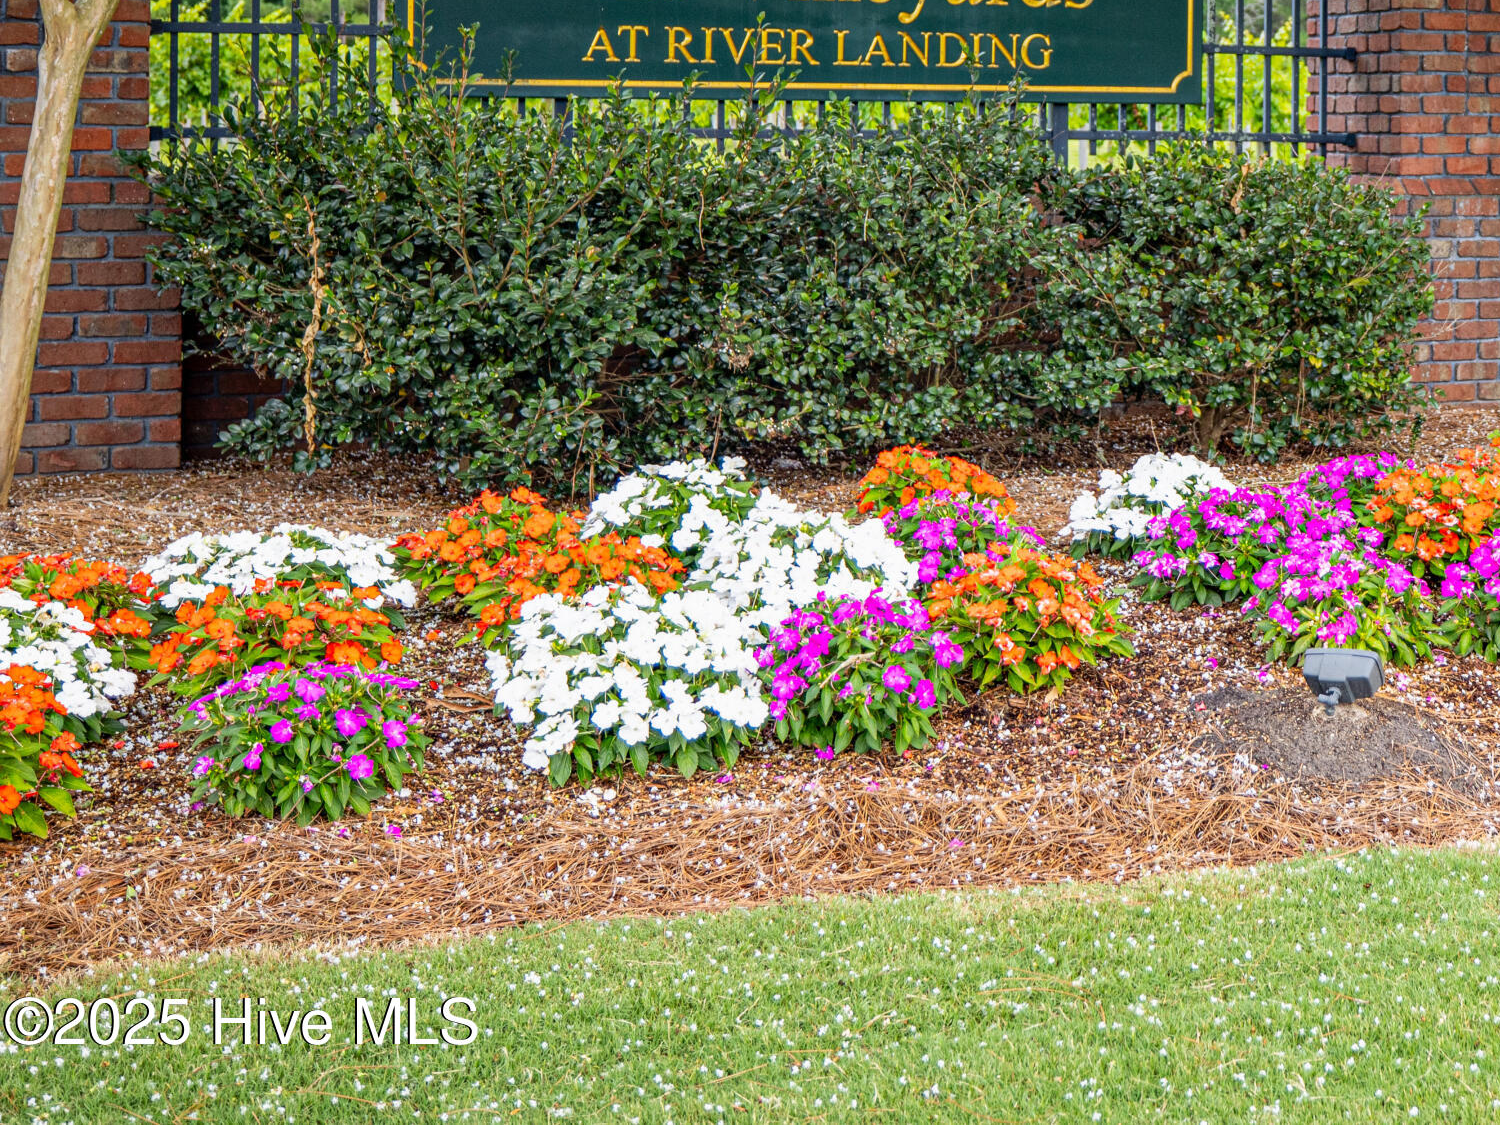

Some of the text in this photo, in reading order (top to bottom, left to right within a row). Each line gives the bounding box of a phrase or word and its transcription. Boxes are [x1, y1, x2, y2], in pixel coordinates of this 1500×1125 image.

[582, 24, 1054, 70] AT RIVER LANDING
